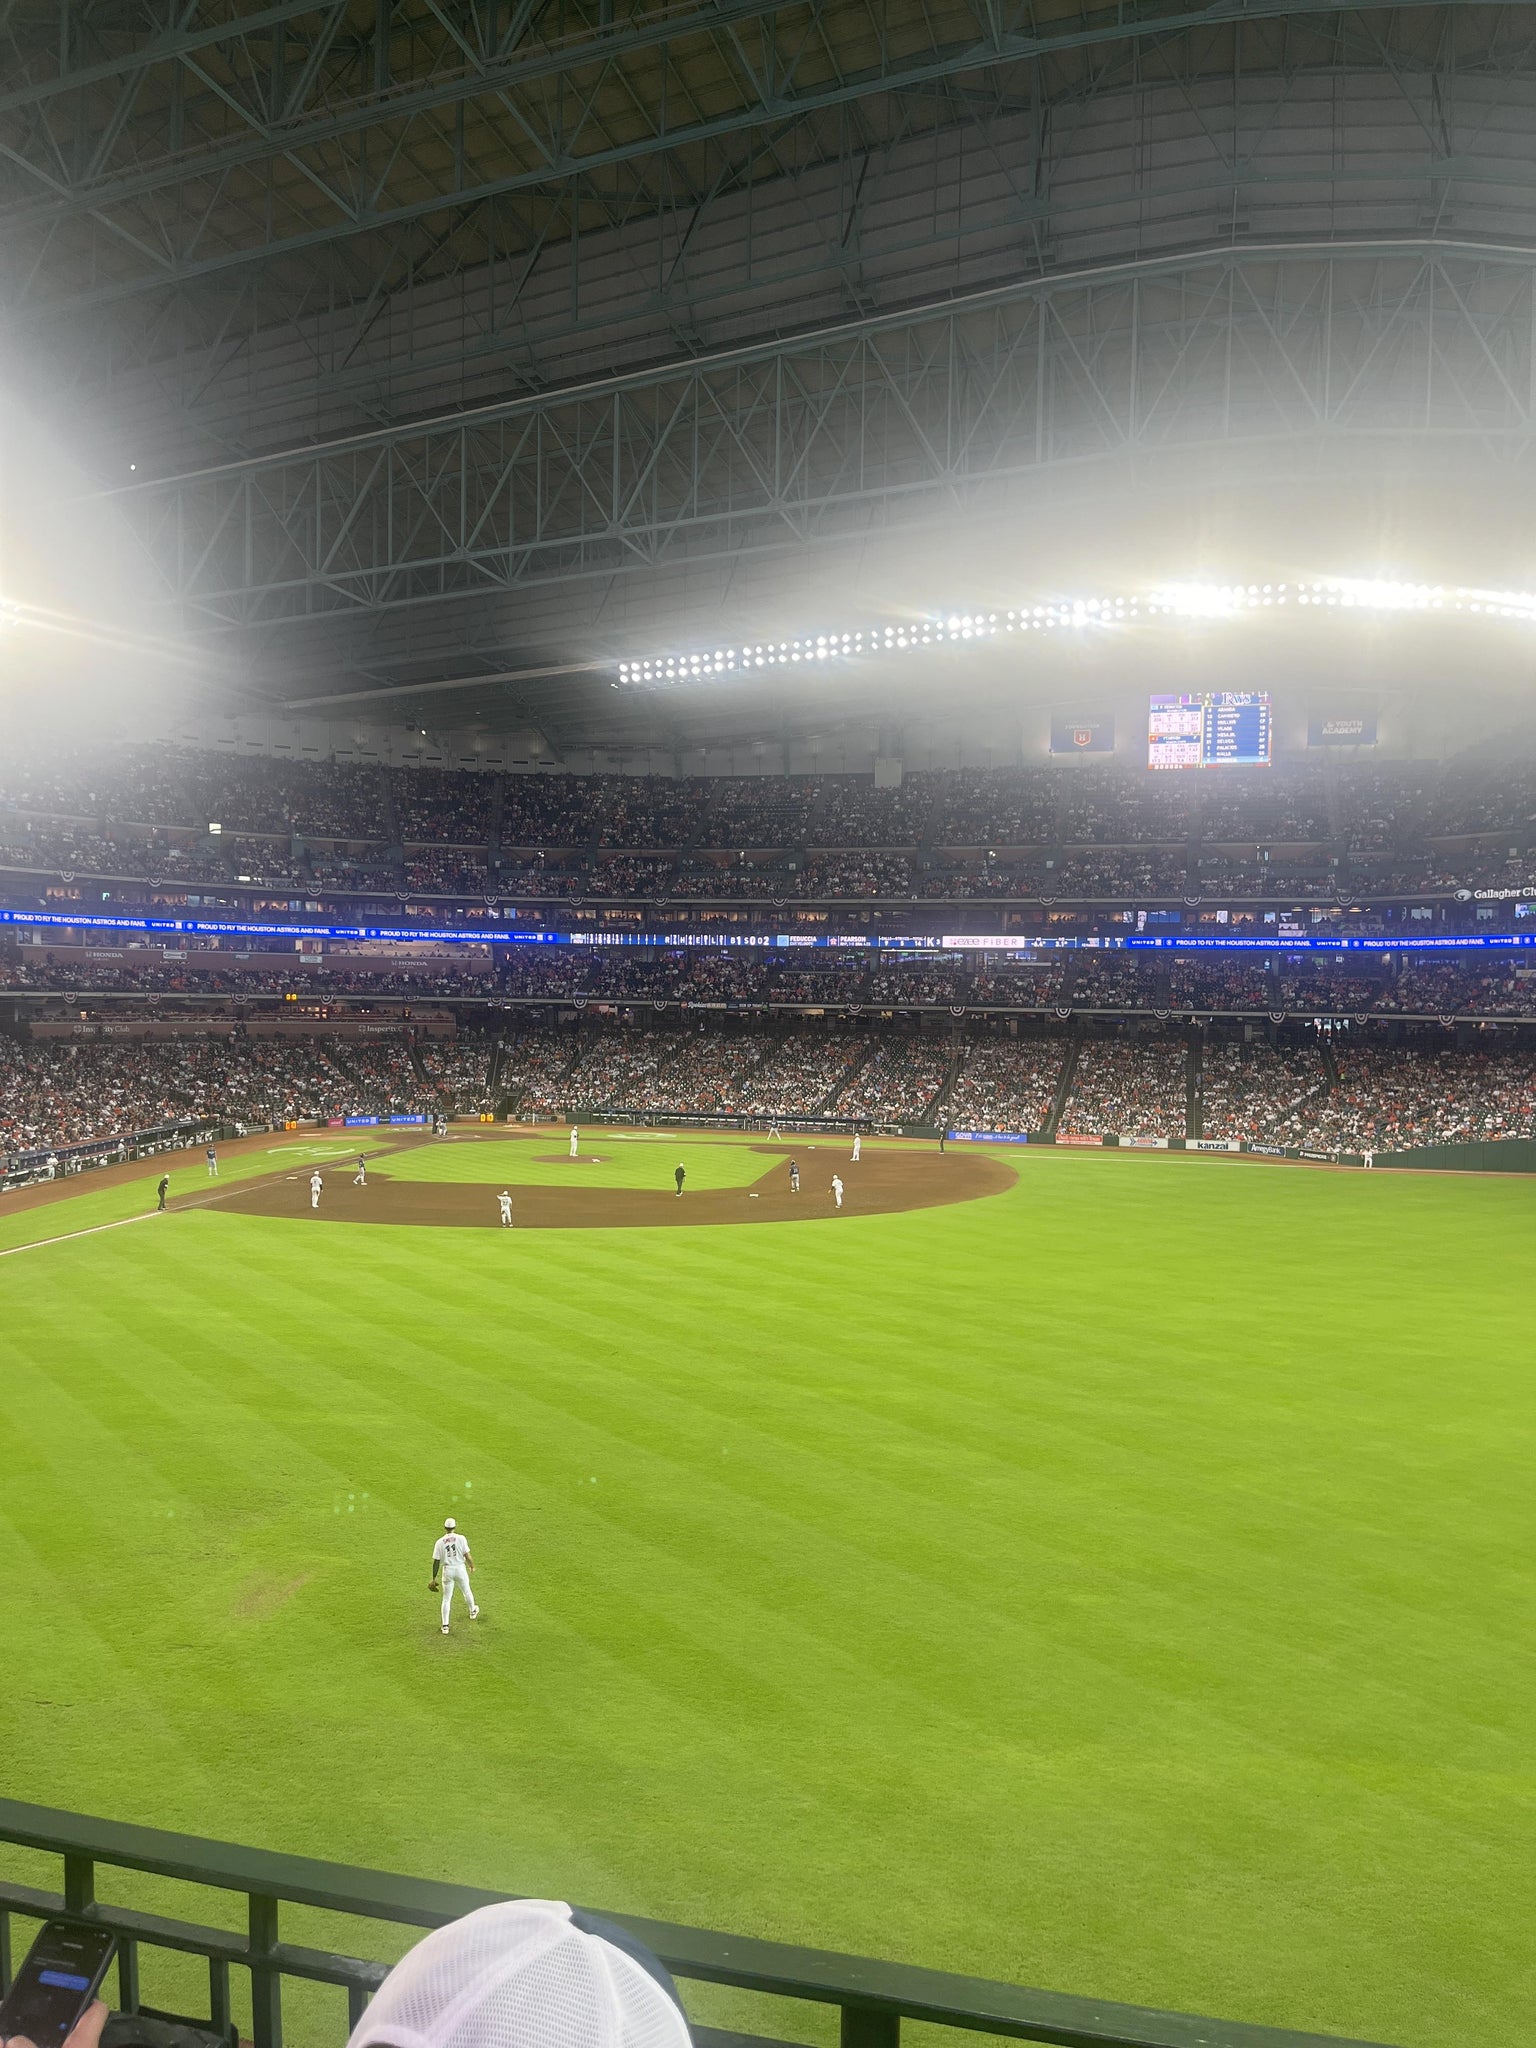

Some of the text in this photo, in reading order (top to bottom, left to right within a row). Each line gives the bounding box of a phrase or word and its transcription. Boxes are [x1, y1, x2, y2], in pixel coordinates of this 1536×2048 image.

[1474, 888, 1521, 899] Gallagher
[13, 913, 34, 921] PROUD
[62, 917, 91, 925] HOUSTON
[730, 936, 736, 944] B
[736, 936, 741, 945] 1
[744, 936, 756, 945] S 0
[763, 936, 770, 946] 2
[927, 936, 935, 947] K
[983, 938, 1017, 946] FIBER
[1434, 938, 1456, 946] ASTROS
[1469, 937, 1485, 945] FANS.
[82, 1025, 130, 1034] Insity Club
[445, 1544, 457, 1557] 11
